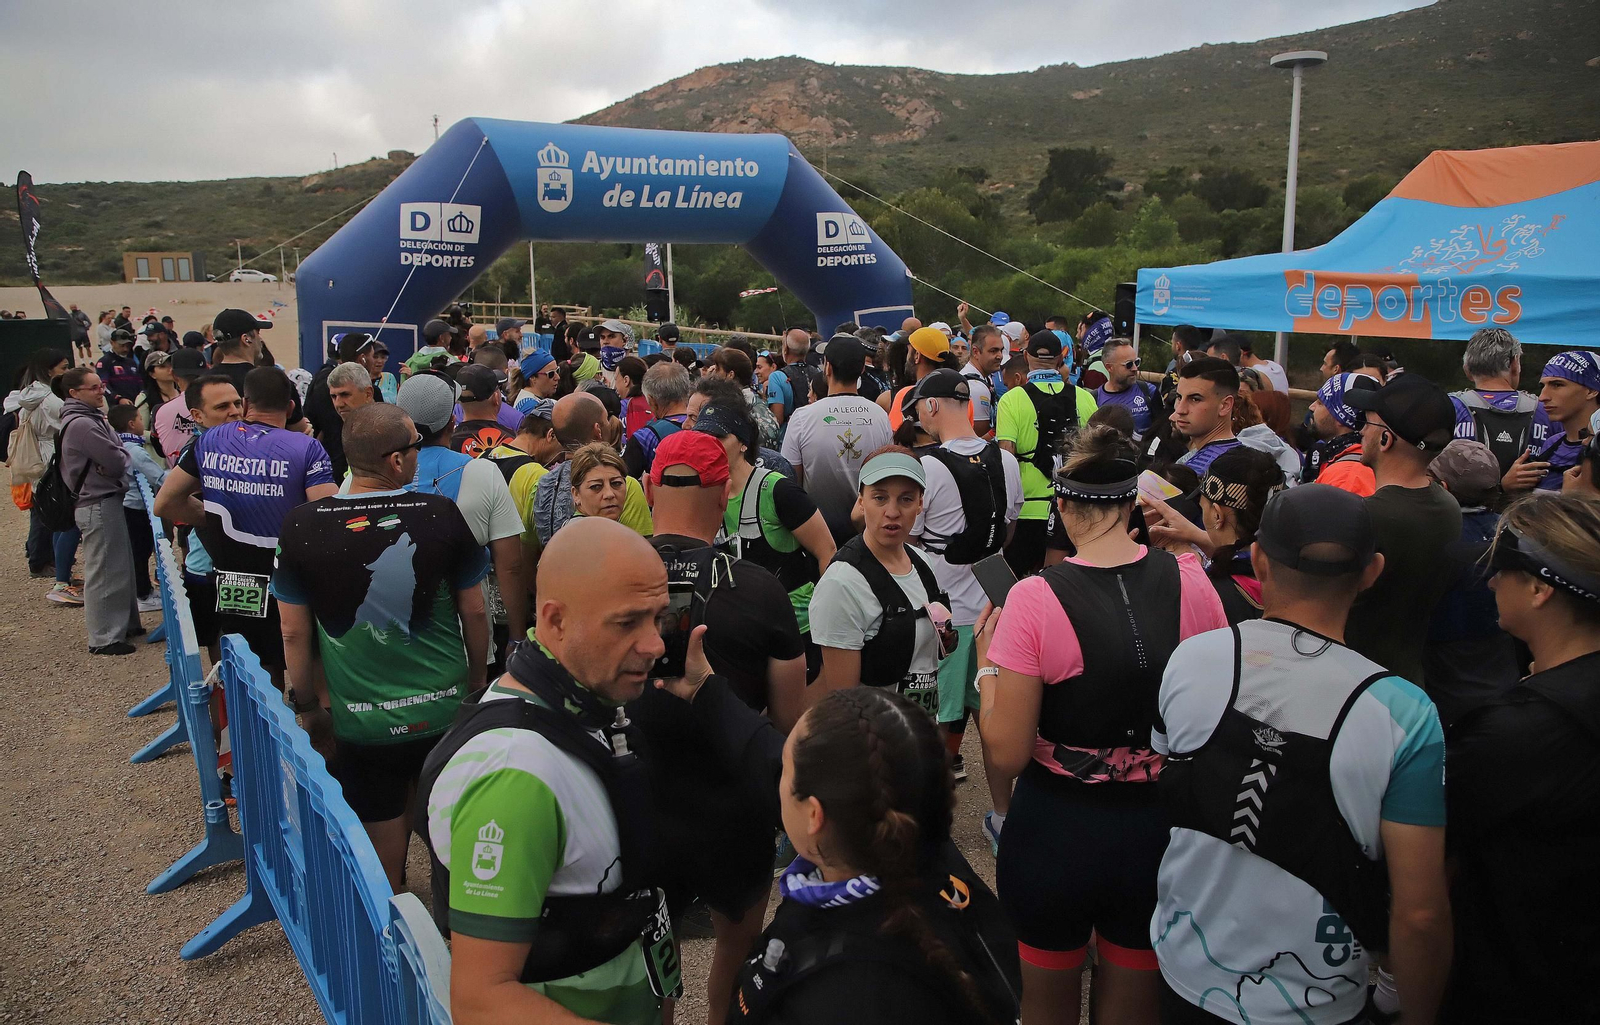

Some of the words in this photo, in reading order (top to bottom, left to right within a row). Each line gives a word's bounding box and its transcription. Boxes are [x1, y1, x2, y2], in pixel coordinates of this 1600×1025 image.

[581, 150, 759, 180] Ayuntamiento
[603, 183, 635, 208] de
[640, 184, 671, 208] La
[675, 184, 743, 208] Línea
[410, 211, 431, 232] D
[824, 220, 840, 238] D
[400, 240, 453, 251] DELEGACIÓN
[454, 244, 465, 252] DE
[817, 244, 857, 253] DELEGACIÓN
[400, 252, 475, 267] DEPORTES
[817, 253, 877, 267] DEPORTES
[1284, 271, 1522, 331] deportes
[1533, 423, 1549, 440] DE
[218, 455, 266, 477] CRESTA
[270, 460, 289, 478] DE
[203, 475, 225, 491] SIERRA
[226, 479, 284, 497] CARBONERA
[221, 579, 259, 588] CARBONERA
[221, 587, 260, 605] 322
[463, 880, 505, 892] Ayuntamiento
[481, 890, 499, 898] Línea
